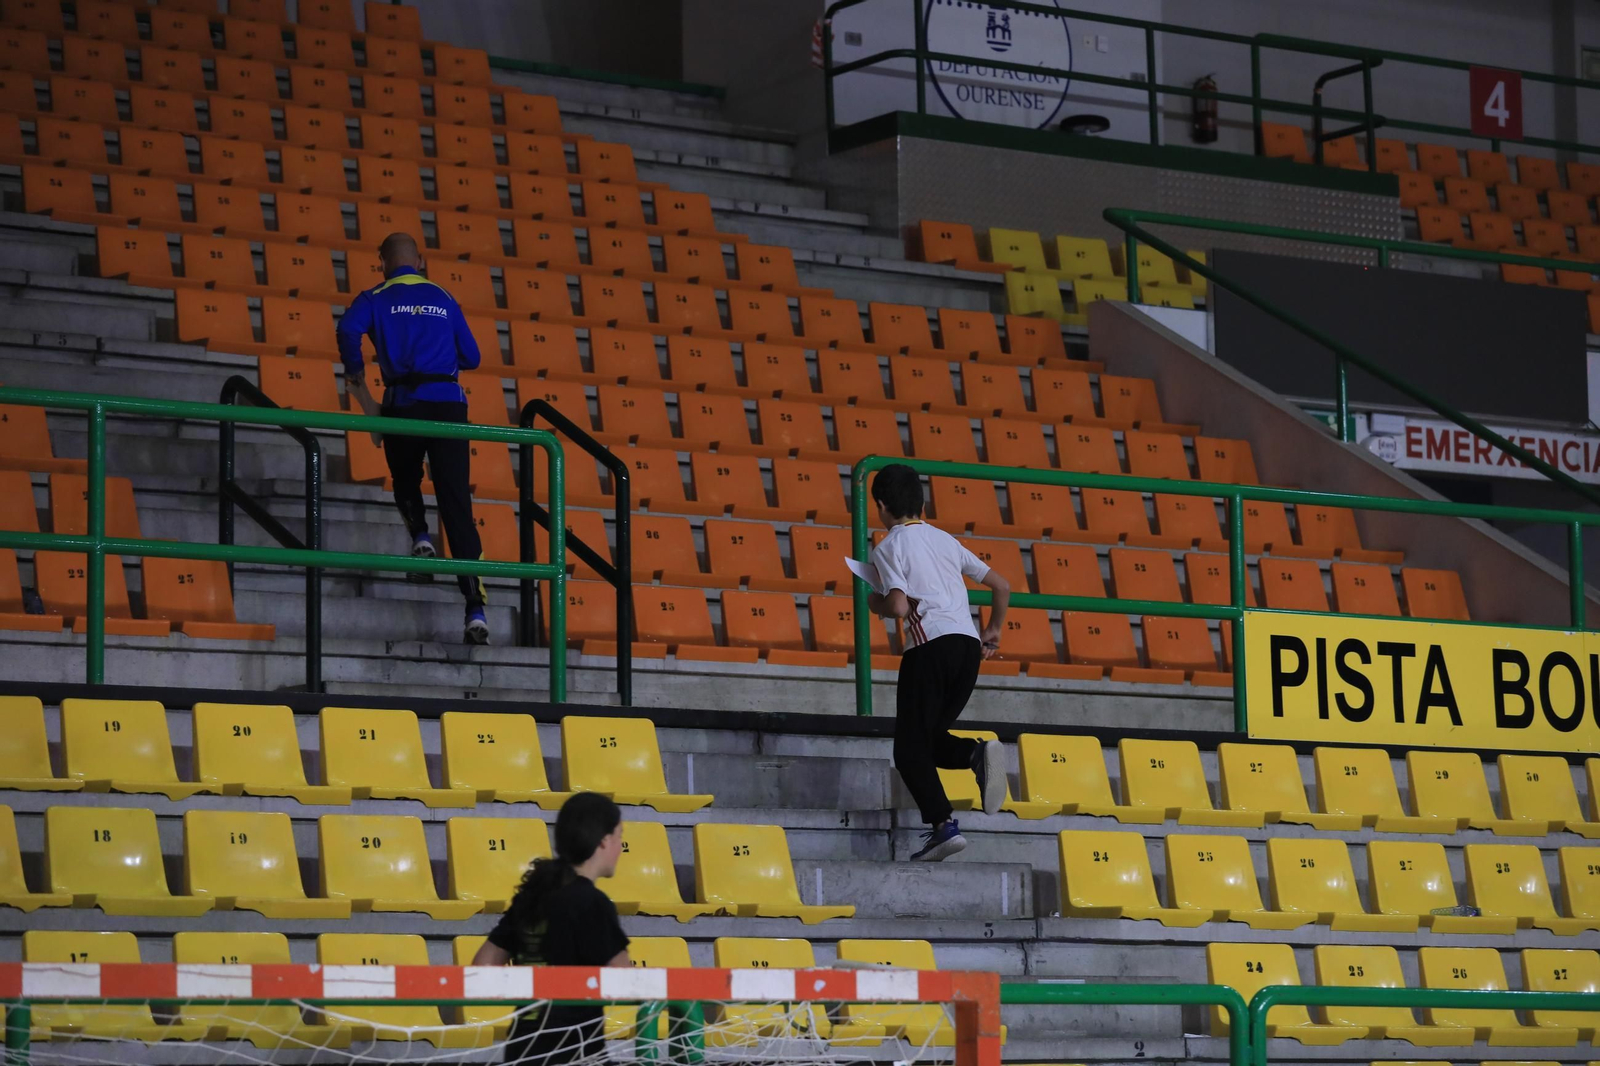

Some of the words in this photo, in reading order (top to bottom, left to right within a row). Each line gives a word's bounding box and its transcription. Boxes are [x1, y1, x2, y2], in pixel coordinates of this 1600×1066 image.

[956, 84, 1045, 110] OURENSE
[1483, 80, 1510, 128] 4
[390, 304, 448, 317] LIMIACTIVA
[67, 568, 85, 579] 22
[568, 595, 585, 606] 24
[837, 611, 851, 621] 27
[1007, 620, 1022, 631] 29
[1270, 634, 1463, 727] PISTA
[1492, 648, 1600, 733] BO
[104, 720, 121, 732] 19
[232, 724, 252, 737] 20
[358, 728, 376, 741] 21
[477, 733, 495, 744] 22
[1050, 752, 1067, 764] 25
[1150, 758, 1165, 769] 26
[1249, 762, 1263, 774] 27
[1343, 765, 1359, 776] 28
[1435, 770, 1449, 780] 29
[93, 829, 112, 843] 18
[230, 832, 248, 845] 19
[360, 836, 382, 849] 20
[488, 838, 506, 851] 21
[1092, 850, 1110, 863] 24
[1197, 851, 1214, 862] 25
[1299, 858, 1315, 869] 26
[1399, 860, 1413, 871] 27
[1495, 862, 1511, 875] 28
[1245, 961, 1264, 974] 24
[1348, 965, 1364, 977] 25
[1452, 967, 1468, 980] 26
[1553, 968, 1568, 981] 27
[1133, 1041, 1145, 1058] 2
